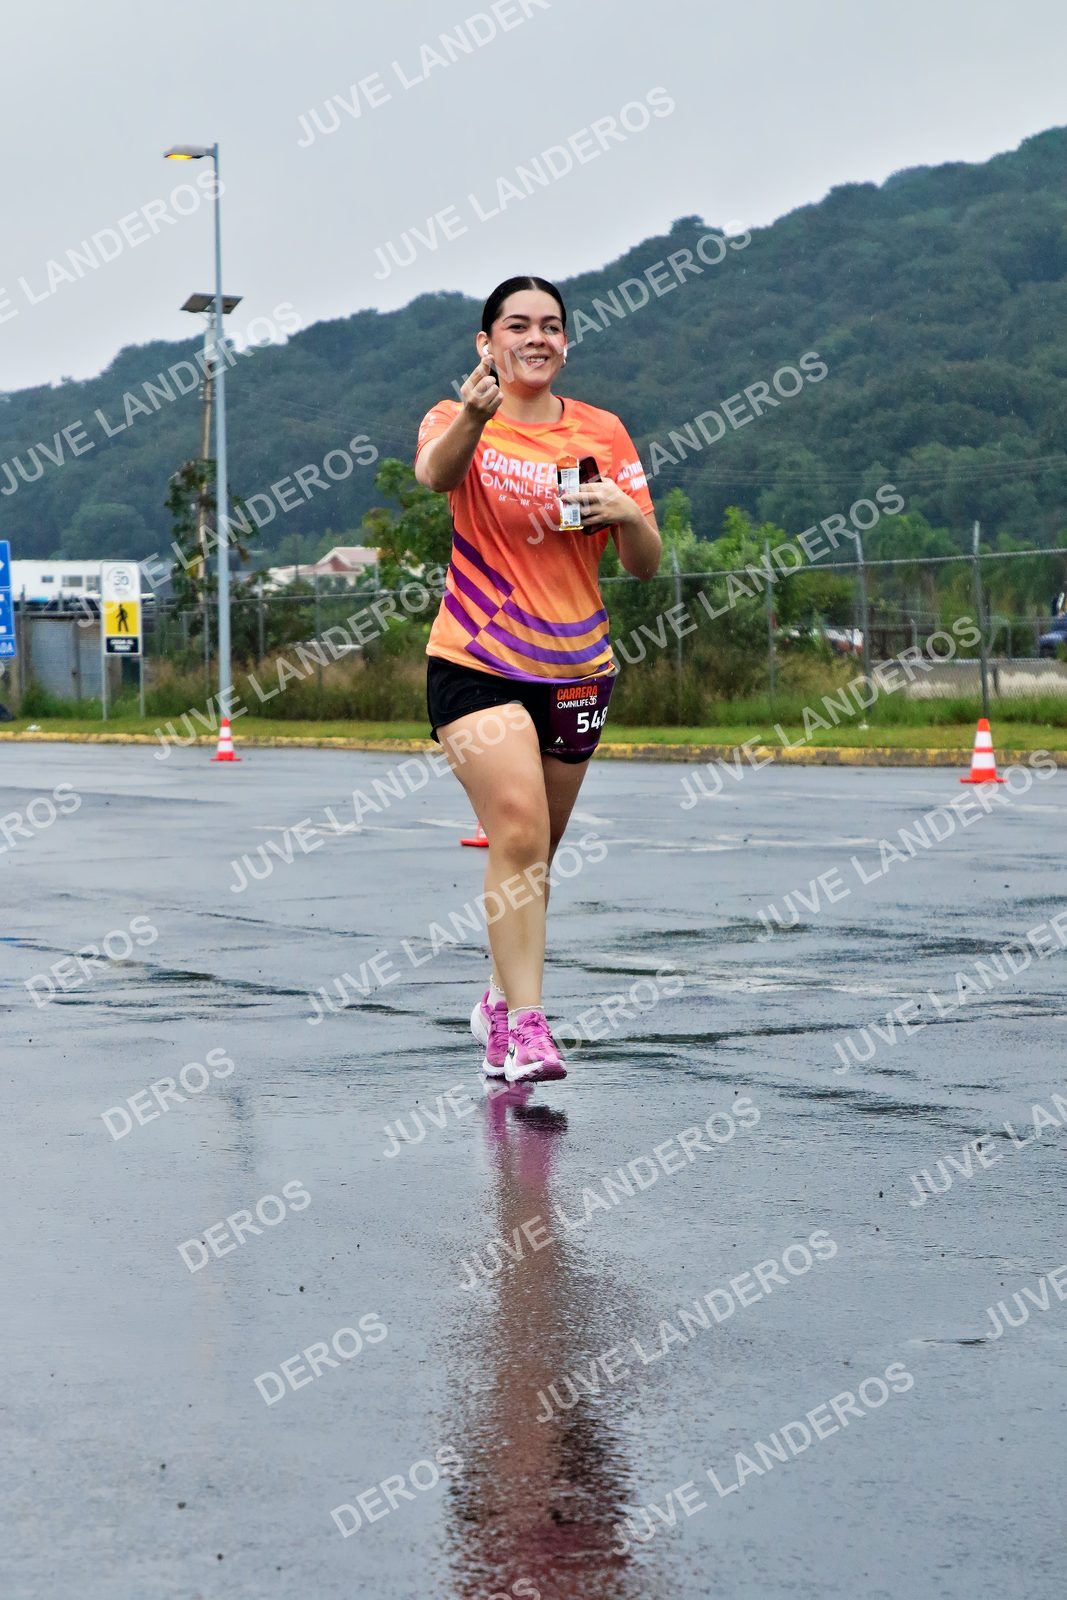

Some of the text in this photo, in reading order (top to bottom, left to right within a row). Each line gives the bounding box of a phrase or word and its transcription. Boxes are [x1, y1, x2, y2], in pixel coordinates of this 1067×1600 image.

[480, 473, 553, 499] OMNILIFE
[113, 575, 129, 586] 30
[556, 685, 598, 701] CARRERA
[556, 698, 589, 709] OMNILIFE
